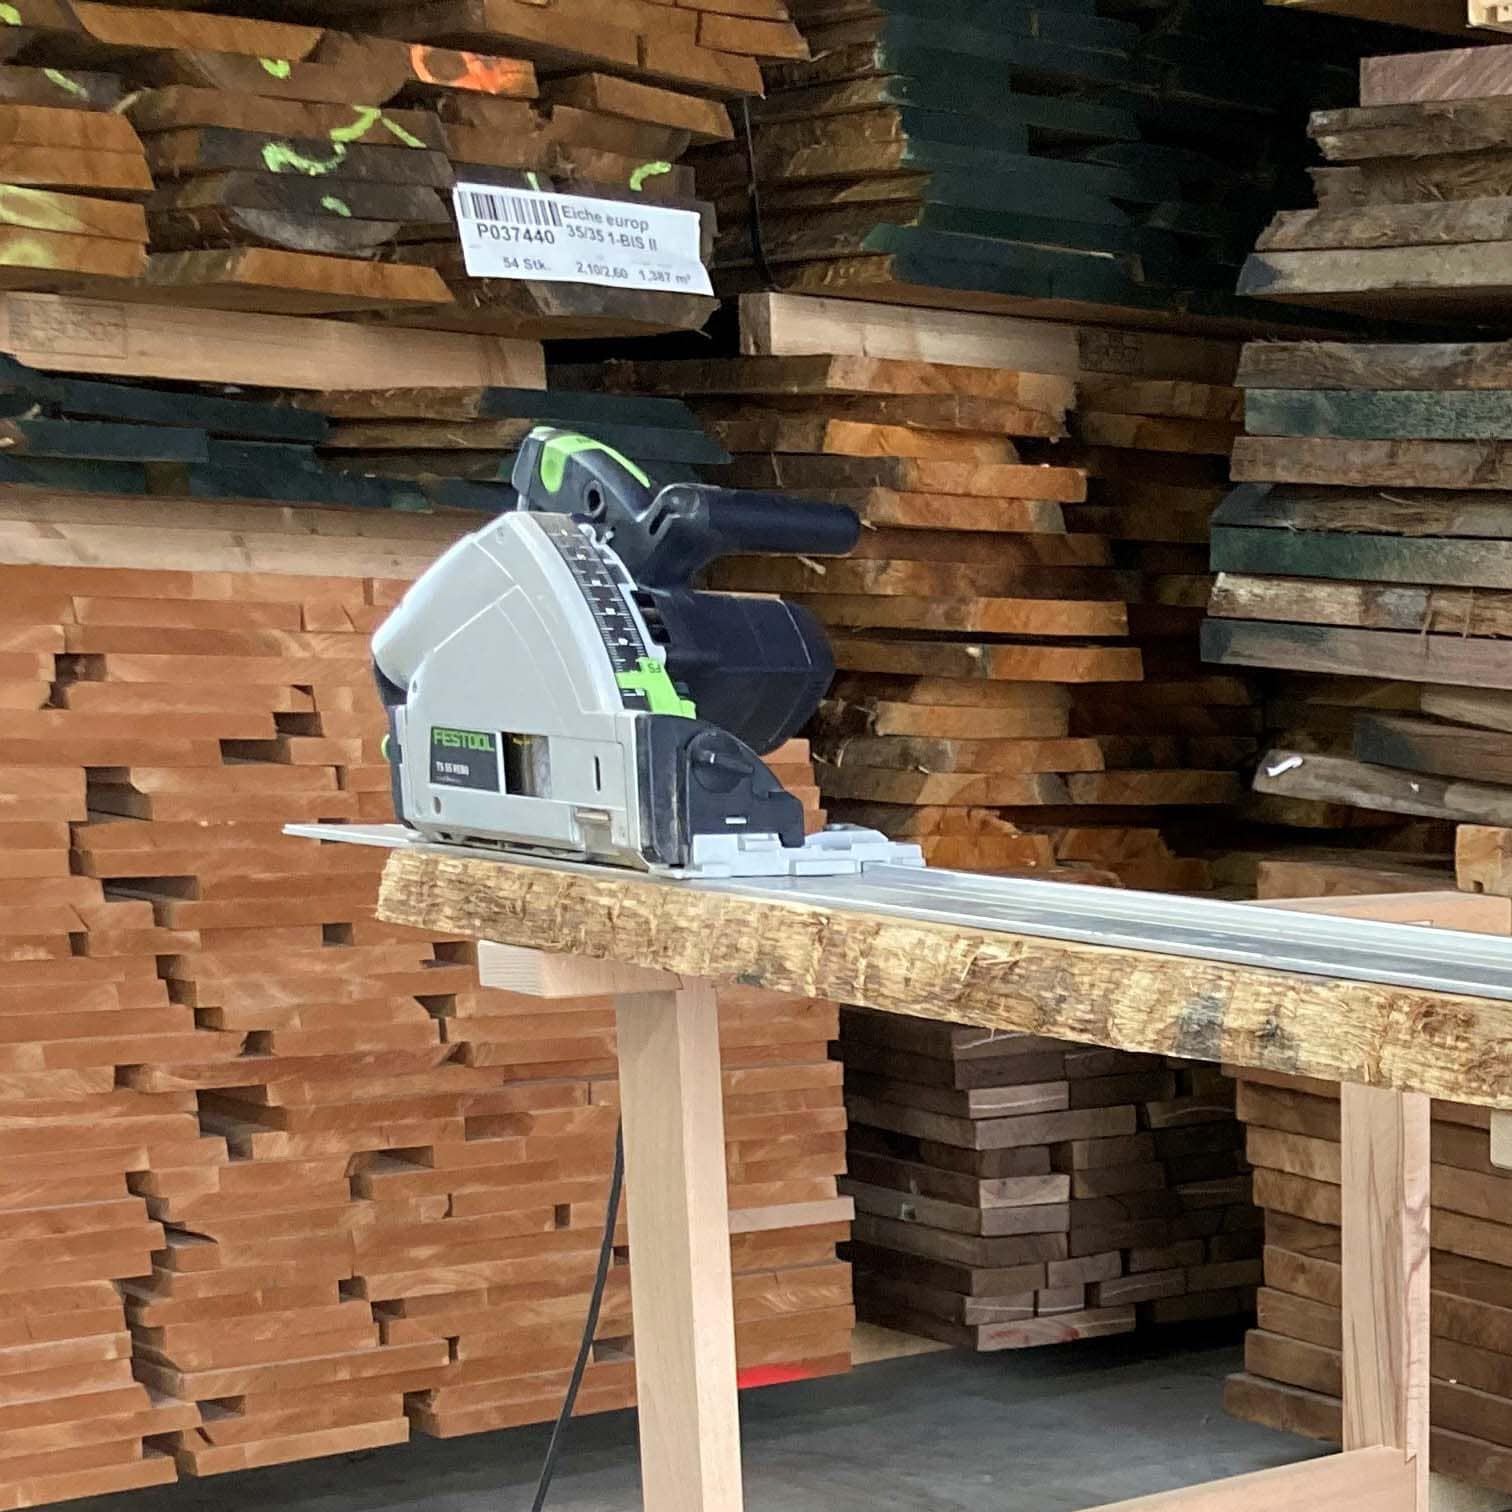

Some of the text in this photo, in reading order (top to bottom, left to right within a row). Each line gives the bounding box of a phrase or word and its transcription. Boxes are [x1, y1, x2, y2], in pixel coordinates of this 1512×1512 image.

[561, 205, 649, 234] Eiche europ
[477, 223, 555, 244] P037440
[566, 224, 658, 251] 35/35 1-BIS II
[503, 257, 519, 269] 54
[433, 728, 495, 752] FESTOOL
